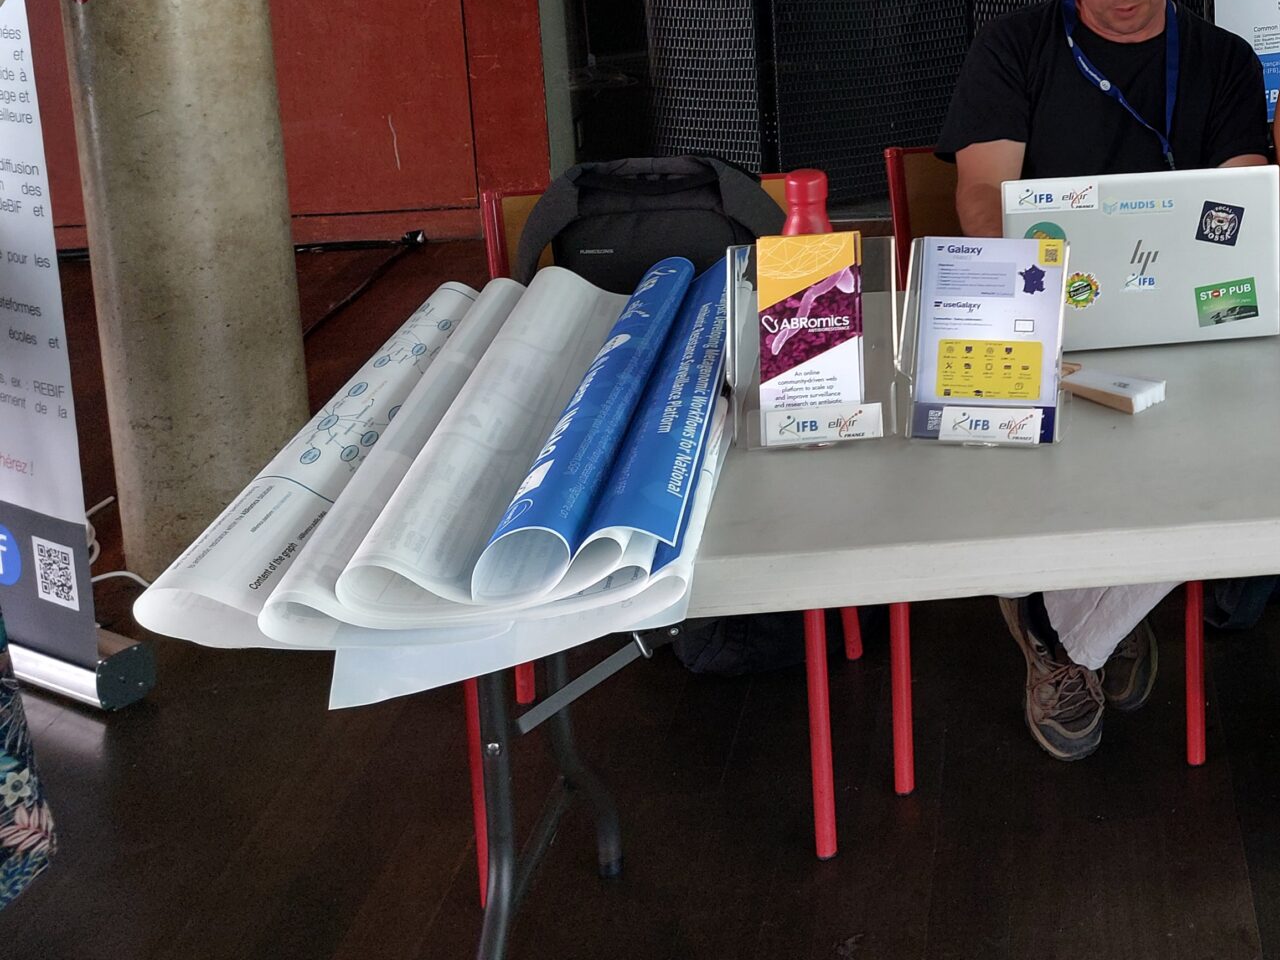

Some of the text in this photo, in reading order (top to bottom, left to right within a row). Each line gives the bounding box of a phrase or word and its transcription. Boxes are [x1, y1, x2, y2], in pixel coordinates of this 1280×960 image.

[1253, 24, 1278, 33] Common
[13, 48, 24, 61] et
[19, 90, 30, 103] et
[21, 182, 42, 197] des
[1034, 193, 1053, 204] IFB
[33, 203, 44, 218] et
[947, 244, 983, 256] Galaxy
[8, 250, 51, 270] pour les
[1138, 278, 1155, 287] IFB
[1228, 283, 1252, 296] PUB
[943, 301, 981, 310] useGalaxy
[9, 326, 60, 349] écoles et
[697, 347, 720, 396] Metagenomic
[669, 359, 694, 401] Surveillance
[34, 379, 65, 399] REBIF
[35, 398, 68, 419] de la
[658, 400, 682, 433] Platform
[682, 395, 709, 439] Workflows
[796, 420, 818, 433] IFB
[969, 419, 990, 431] IFB
[678, 438, 697, 452] for
[667, 452, 692, 498] National
[249, 569, 272, 590] Content
[275, 553, 285, 567] the
[282, 541, 298, 559] graph
